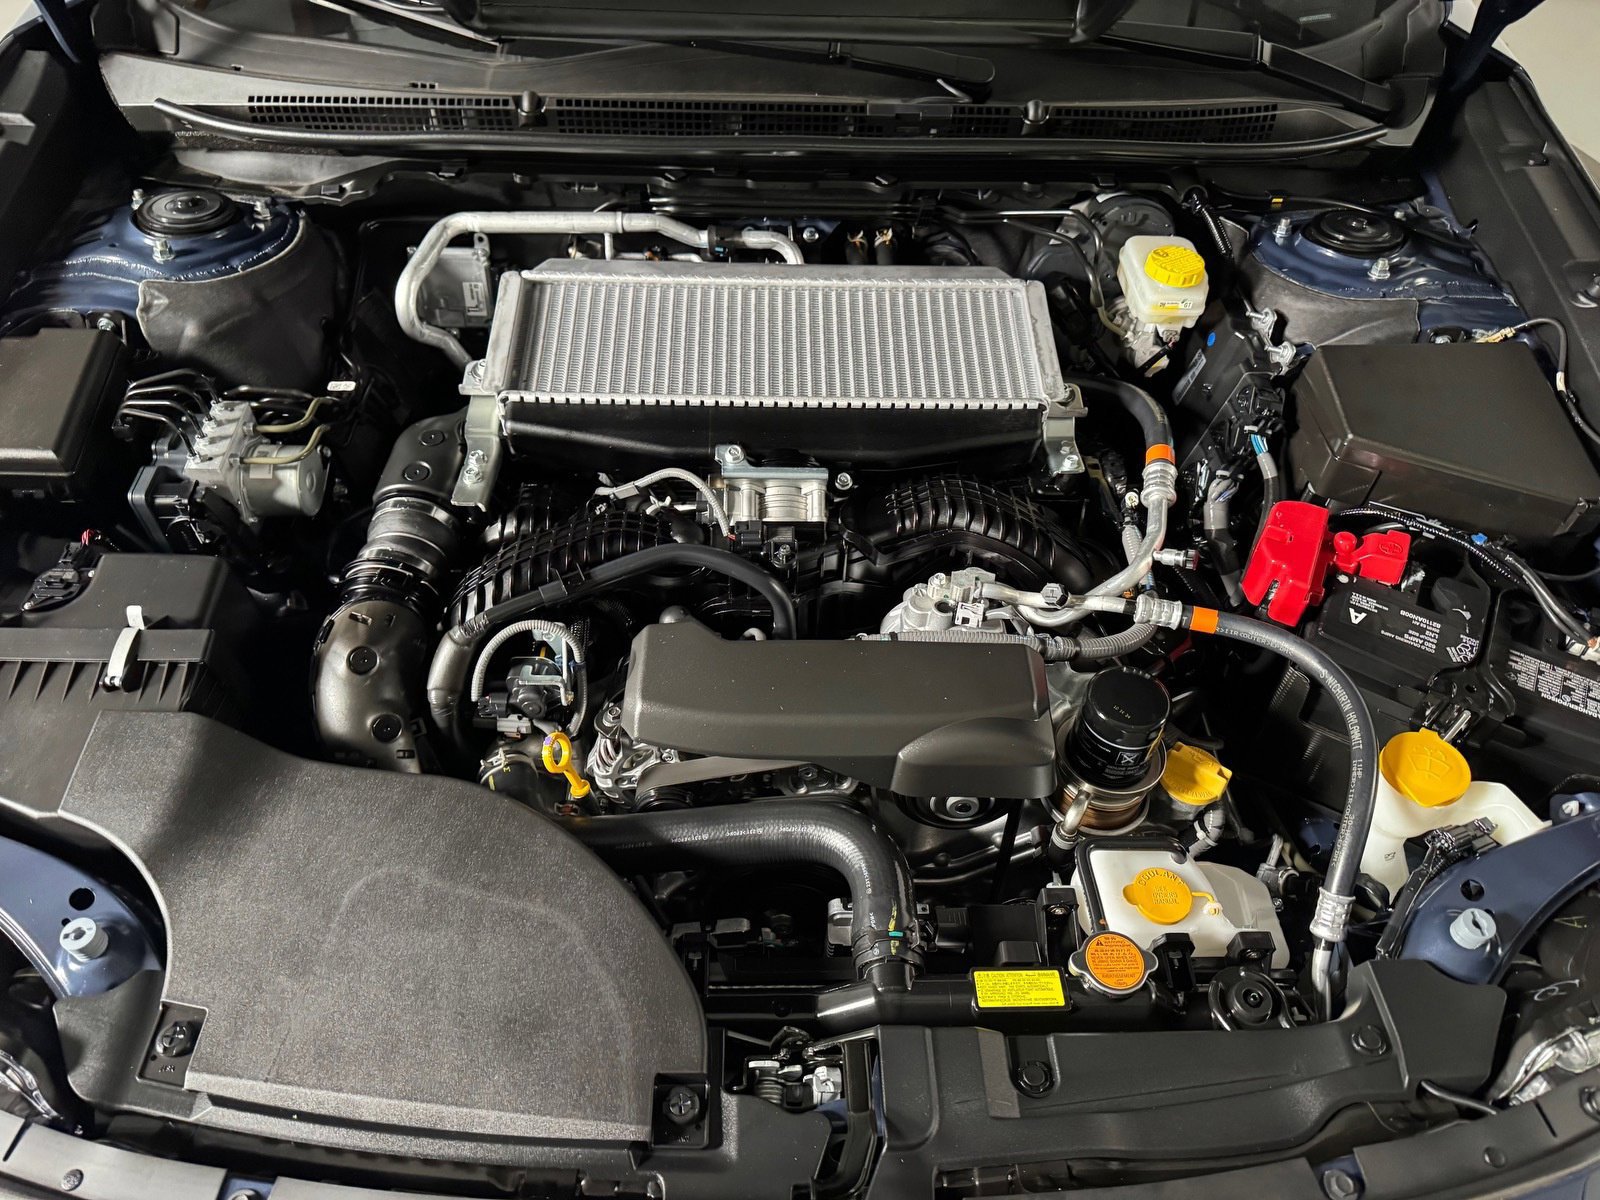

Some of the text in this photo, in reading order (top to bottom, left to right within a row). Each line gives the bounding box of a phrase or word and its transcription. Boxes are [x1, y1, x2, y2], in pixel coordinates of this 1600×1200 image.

[1402, 632, 1423, 644] AMPS
[1424, 629, 1438, 639] LN2
[1138, 869, 1185, 887] COOLANT
